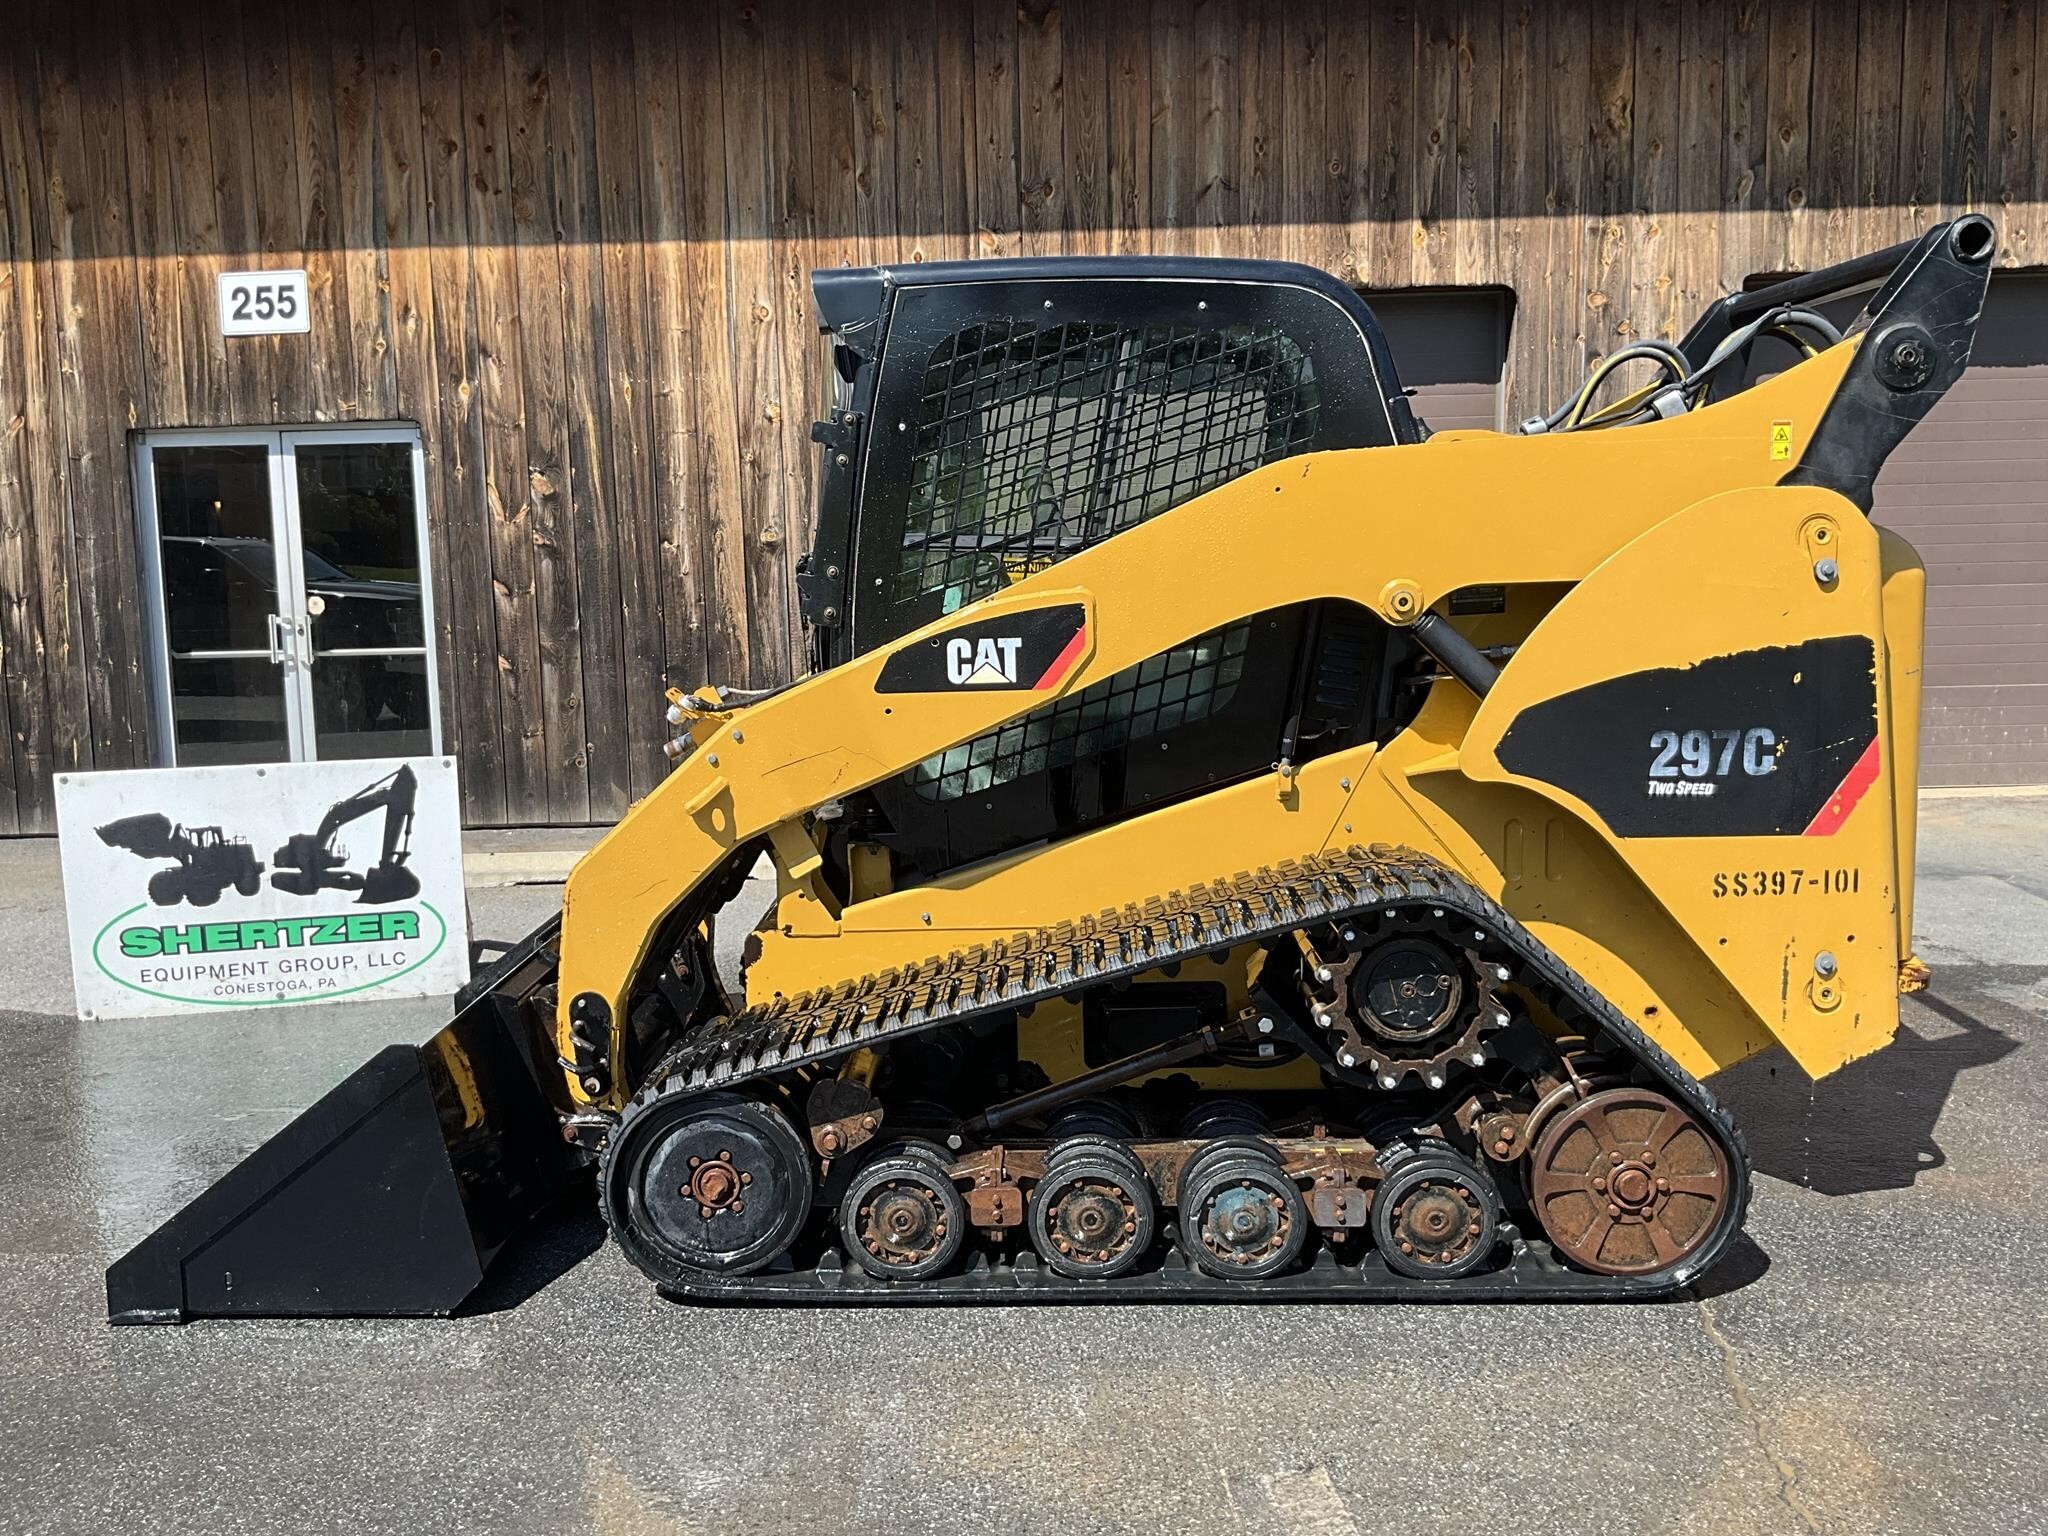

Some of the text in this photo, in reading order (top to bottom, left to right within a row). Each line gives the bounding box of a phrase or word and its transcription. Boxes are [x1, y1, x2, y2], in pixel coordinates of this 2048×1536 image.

[231, 285, 297, 320] 255
[947, 638, 1022, 684] CAT
[1650, 728, 1775, 777] 297C
[120, 911, 418, 957] SHERTZER
[140, 951, 407, 983] EQUIPMENT GROUP, LLC
[213, 977, 337, 995] CONESTOGA, PA
